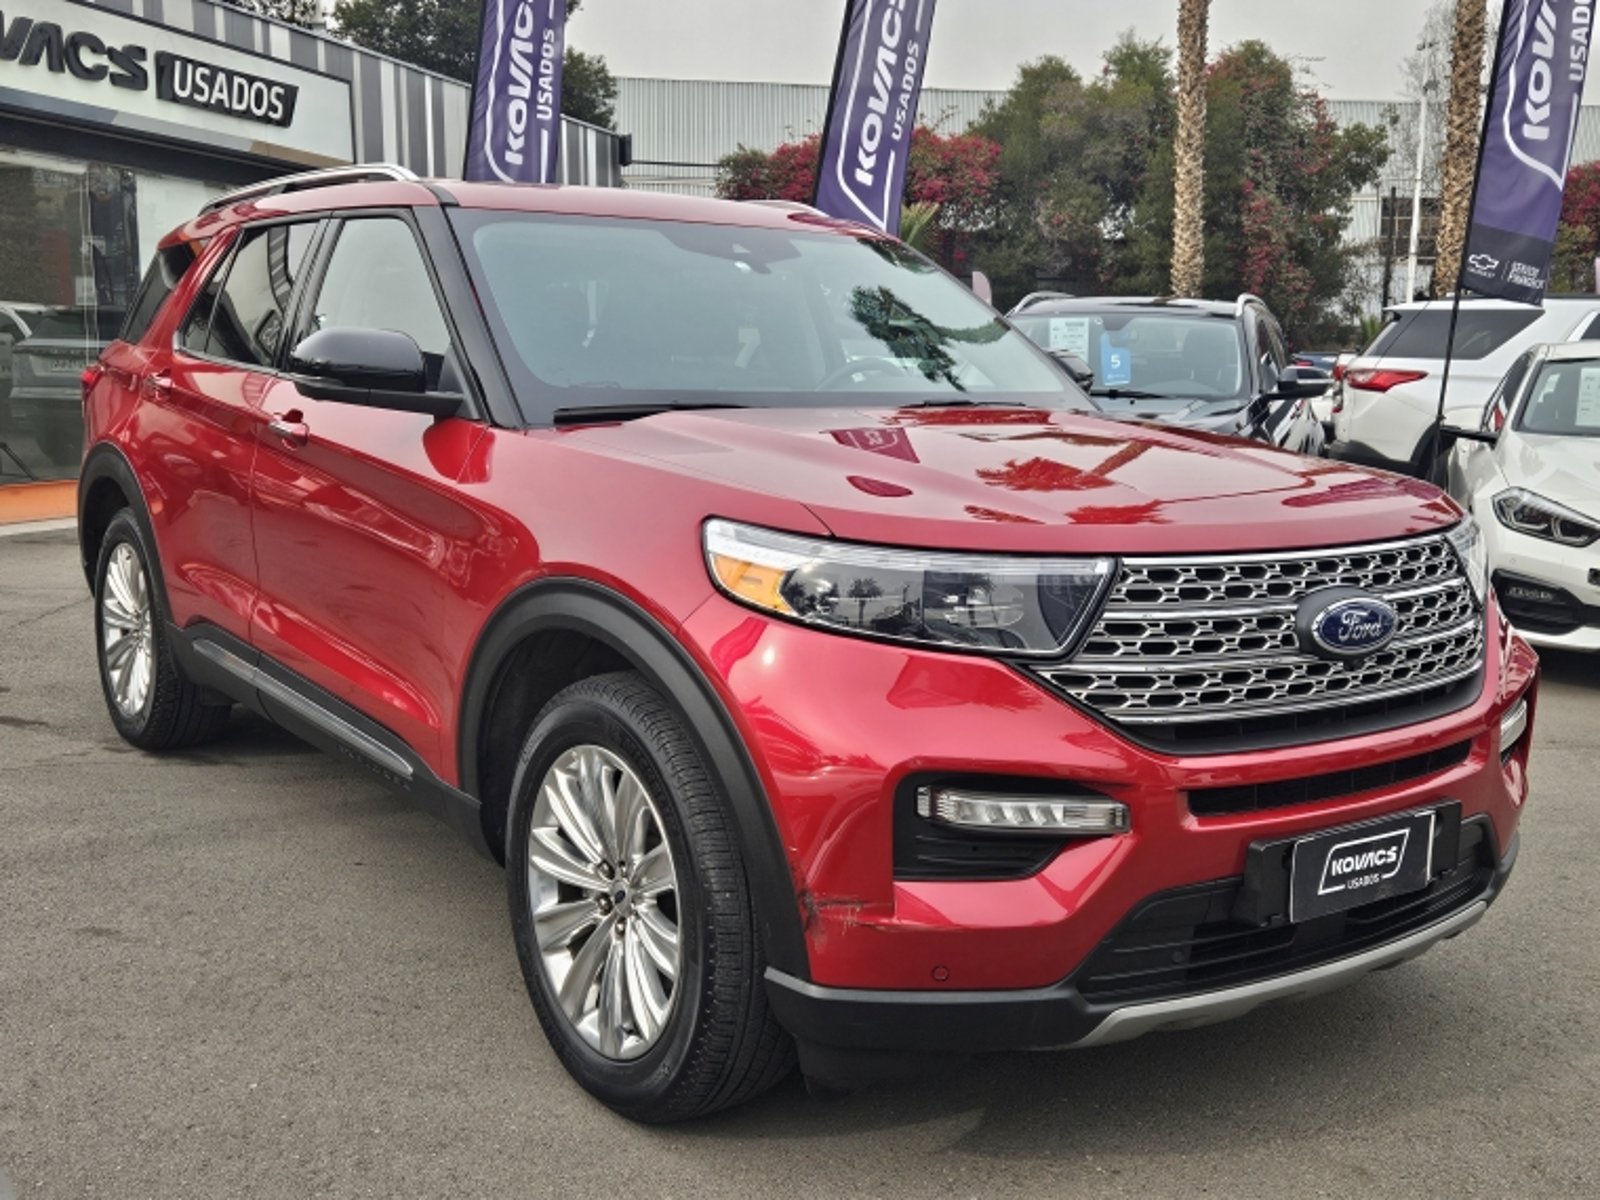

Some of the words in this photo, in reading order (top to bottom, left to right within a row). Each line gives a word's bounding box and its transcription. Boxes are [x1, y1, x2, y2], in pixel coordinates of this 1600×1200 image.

[1568, 0, 1591, 81] USAD
[173, 60, 285, 119] USADOS
[505, 0, 534, 165] KOVAC
[536, 28, 555, 121] USADOS
[891, 40, 919, 141] USADOS
[1111, 354, 1121, 369] 5
[1338, 609, 1382, 642] Ford
[1331, 846, 1398, 876] KOVACS
[1347, 873, 1380, 889] USADOS
